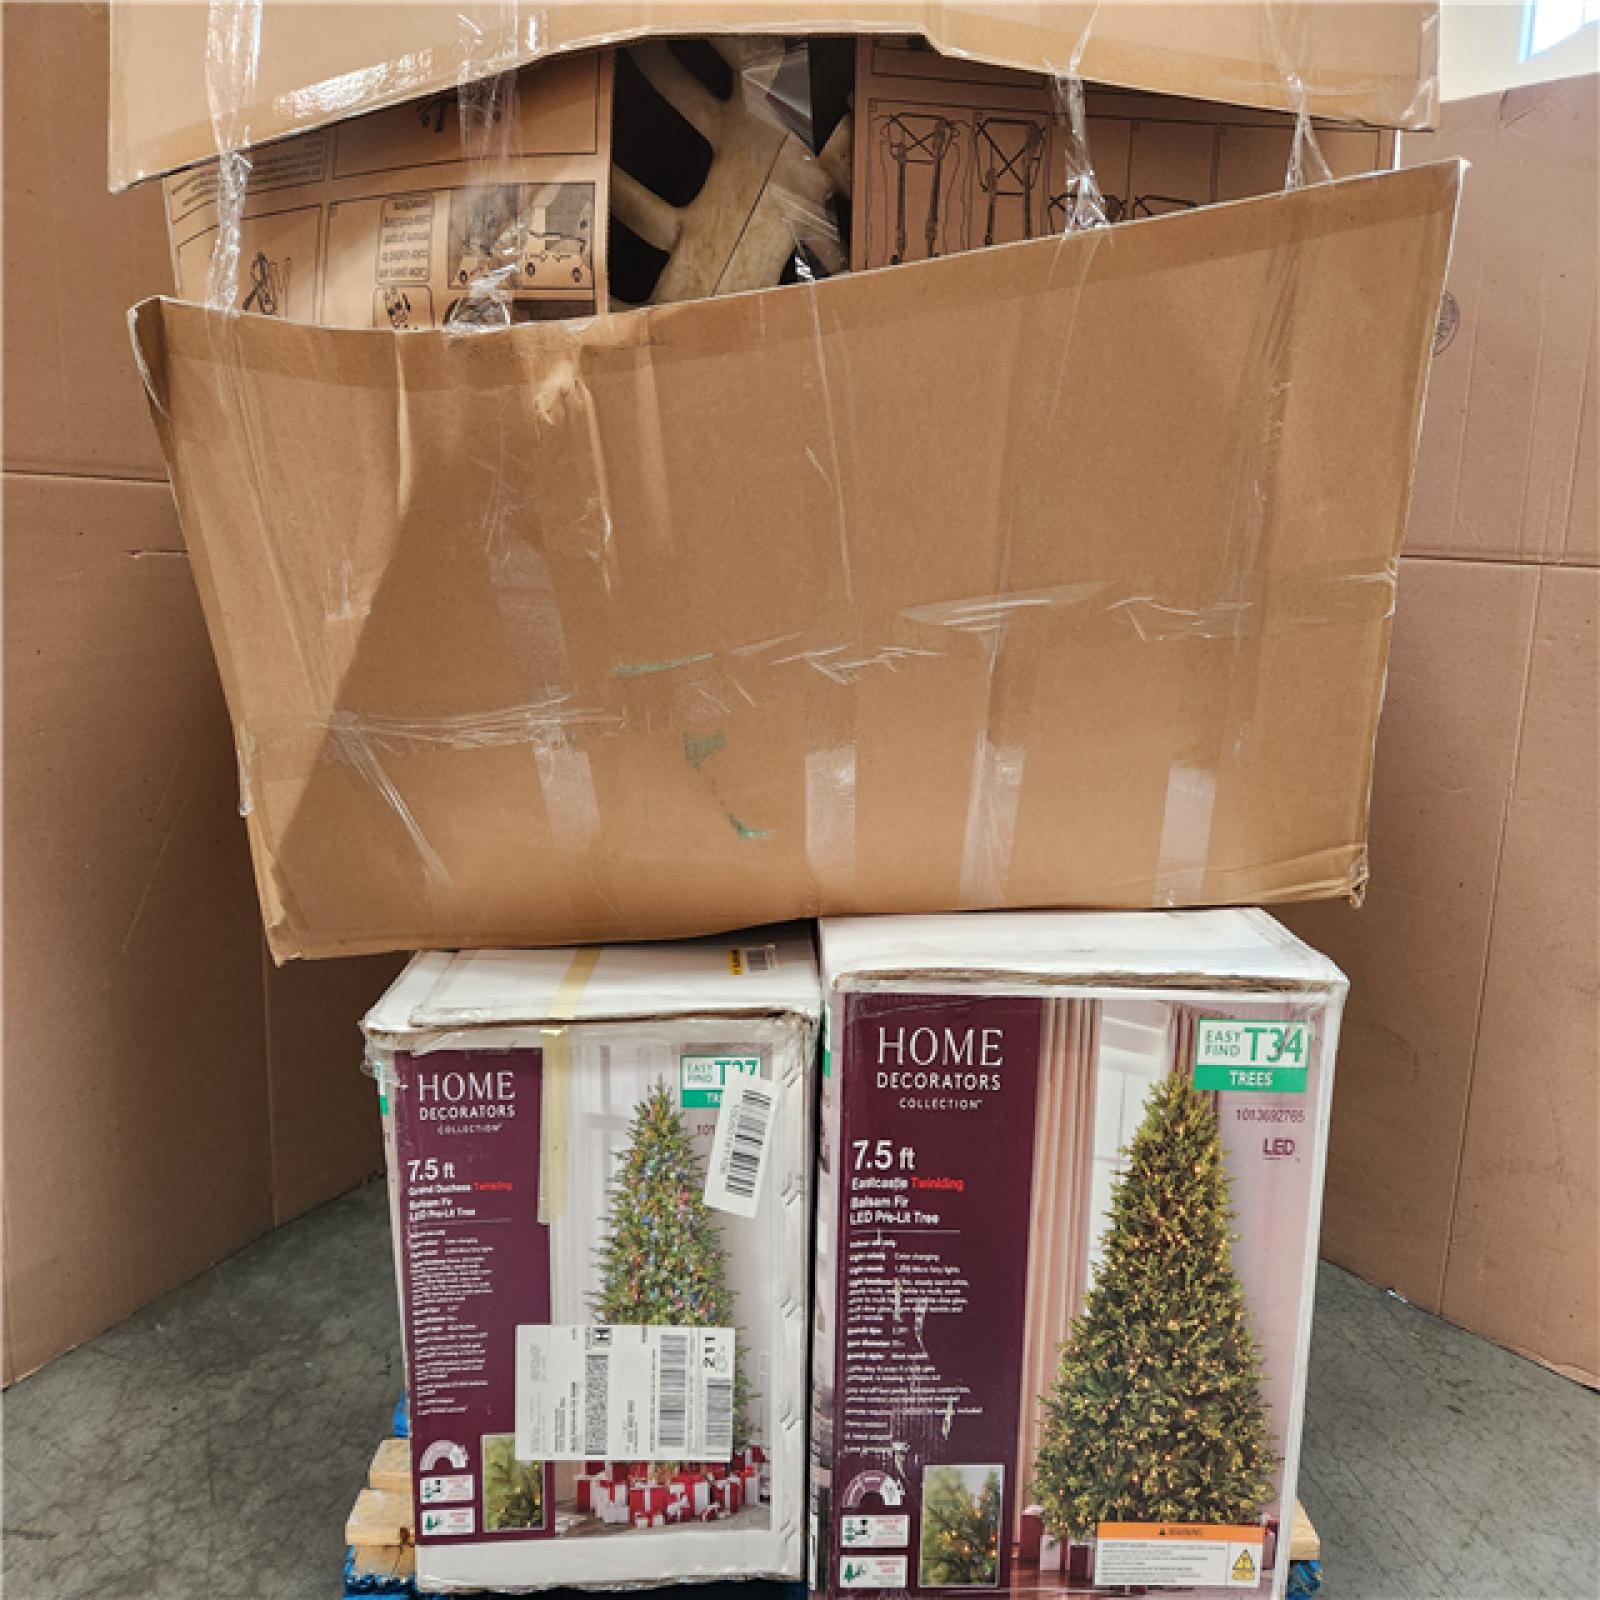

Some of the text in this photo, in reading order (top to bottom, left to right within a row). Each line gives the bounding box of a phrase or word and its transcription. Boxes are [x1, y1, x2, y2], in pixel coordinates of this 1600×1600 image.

[877, 1026, 1003, 1066] HOME
[1204, 1029, 1241, 1044] EASY
[1243, 1026, 1303, 1063] T34
[1204, 1044, 1241, 1057] FIND
[417, 1071, 516, 1102] HOME
[877, 1071, 1002, 1091] DECORATORS
[1229, 1069, 1274, 1087] TREES
[419, 1104, 516, 1121] DECORATORS
[852, 1139, 917, 1171] 7.5 ft
[1262, 1136, 1296, 1156] LED
[407, 1157, 456, 1183] 7.5 ft
[849, 1209, 874, 1225] LED
[914, 1210, 940, 1225] Tree
[702, 1335, 717, 1368] 211
